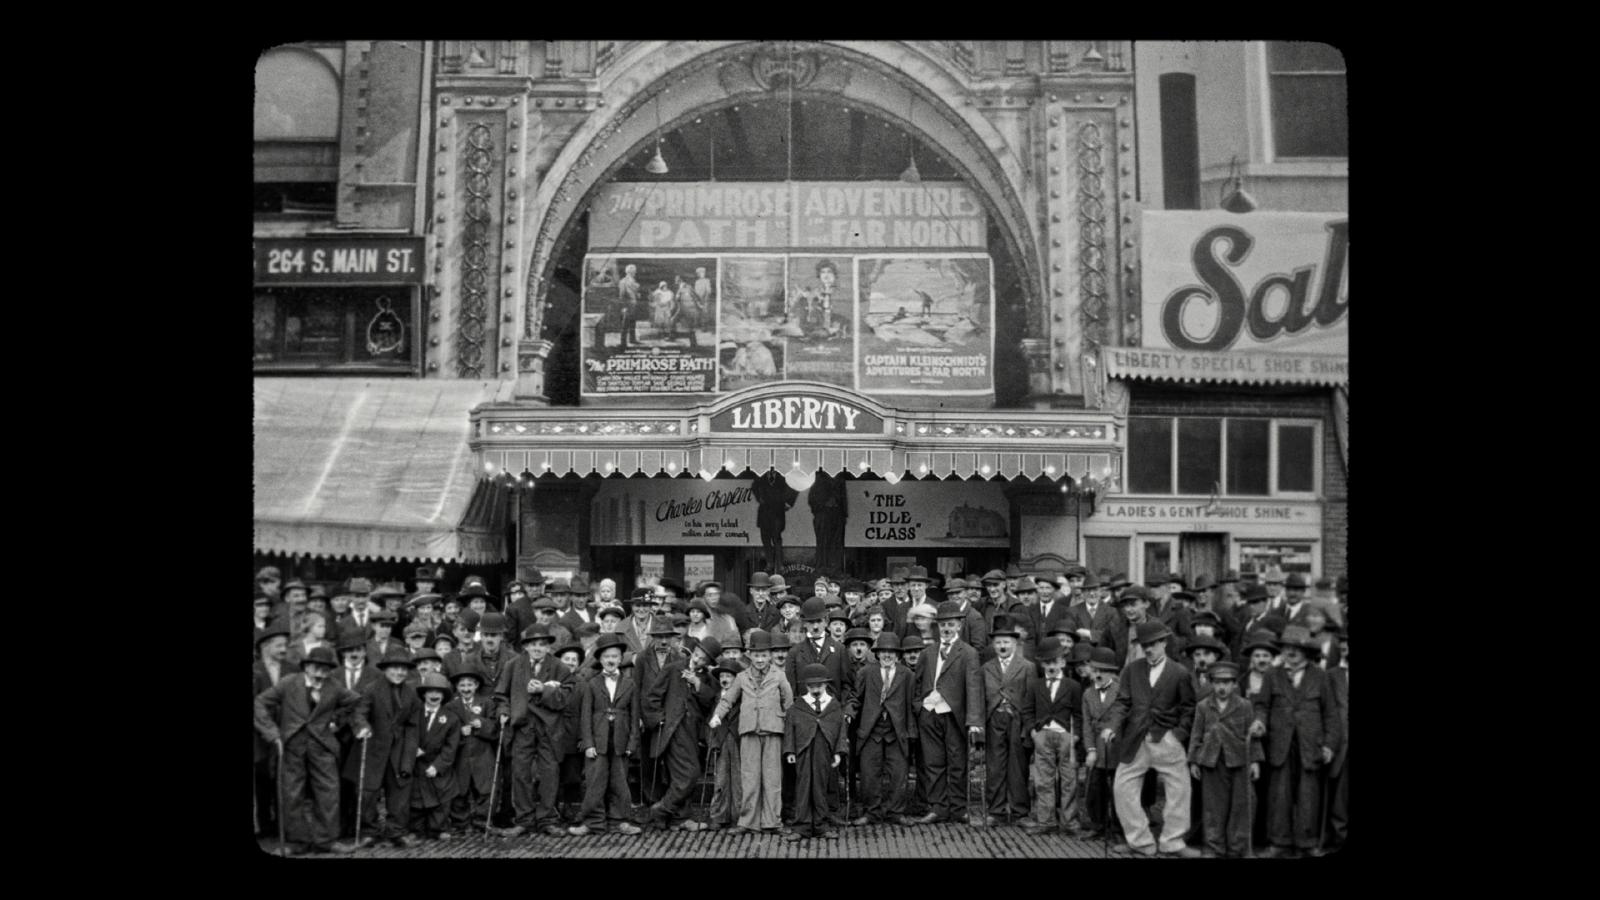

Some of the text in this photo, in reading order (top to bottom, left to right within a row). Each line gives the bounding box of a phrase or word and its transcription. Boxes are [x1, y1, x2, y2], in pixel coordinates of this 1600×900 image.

[831, 219, 886, 247] FAR
[893, 219, 980, 248] NORTH
[268, 248, 305, 274] 264
[386, 248, 415, 274] ST.
[606, 358, 678, 371] PRIMROSE
[864, 355, 907, 366] CAPTAIN
[1115, 351, 1348, 374] LIBERTY SPECIAL SHOE SHIN
[865, 366, 921, 377] ADVENTURES
[932, 366, 951, 378] FAR
[952, 366, 985, 377] NORTH
[731, 396, 862, 431] LIBERTY
[655, 487, 753, 522] Charles Chaplin
[1106, 505, 1156, 518] LADIES
[1254, 507, 1292, 520] SHINE
[869, 511, 912, 525] IDLE
